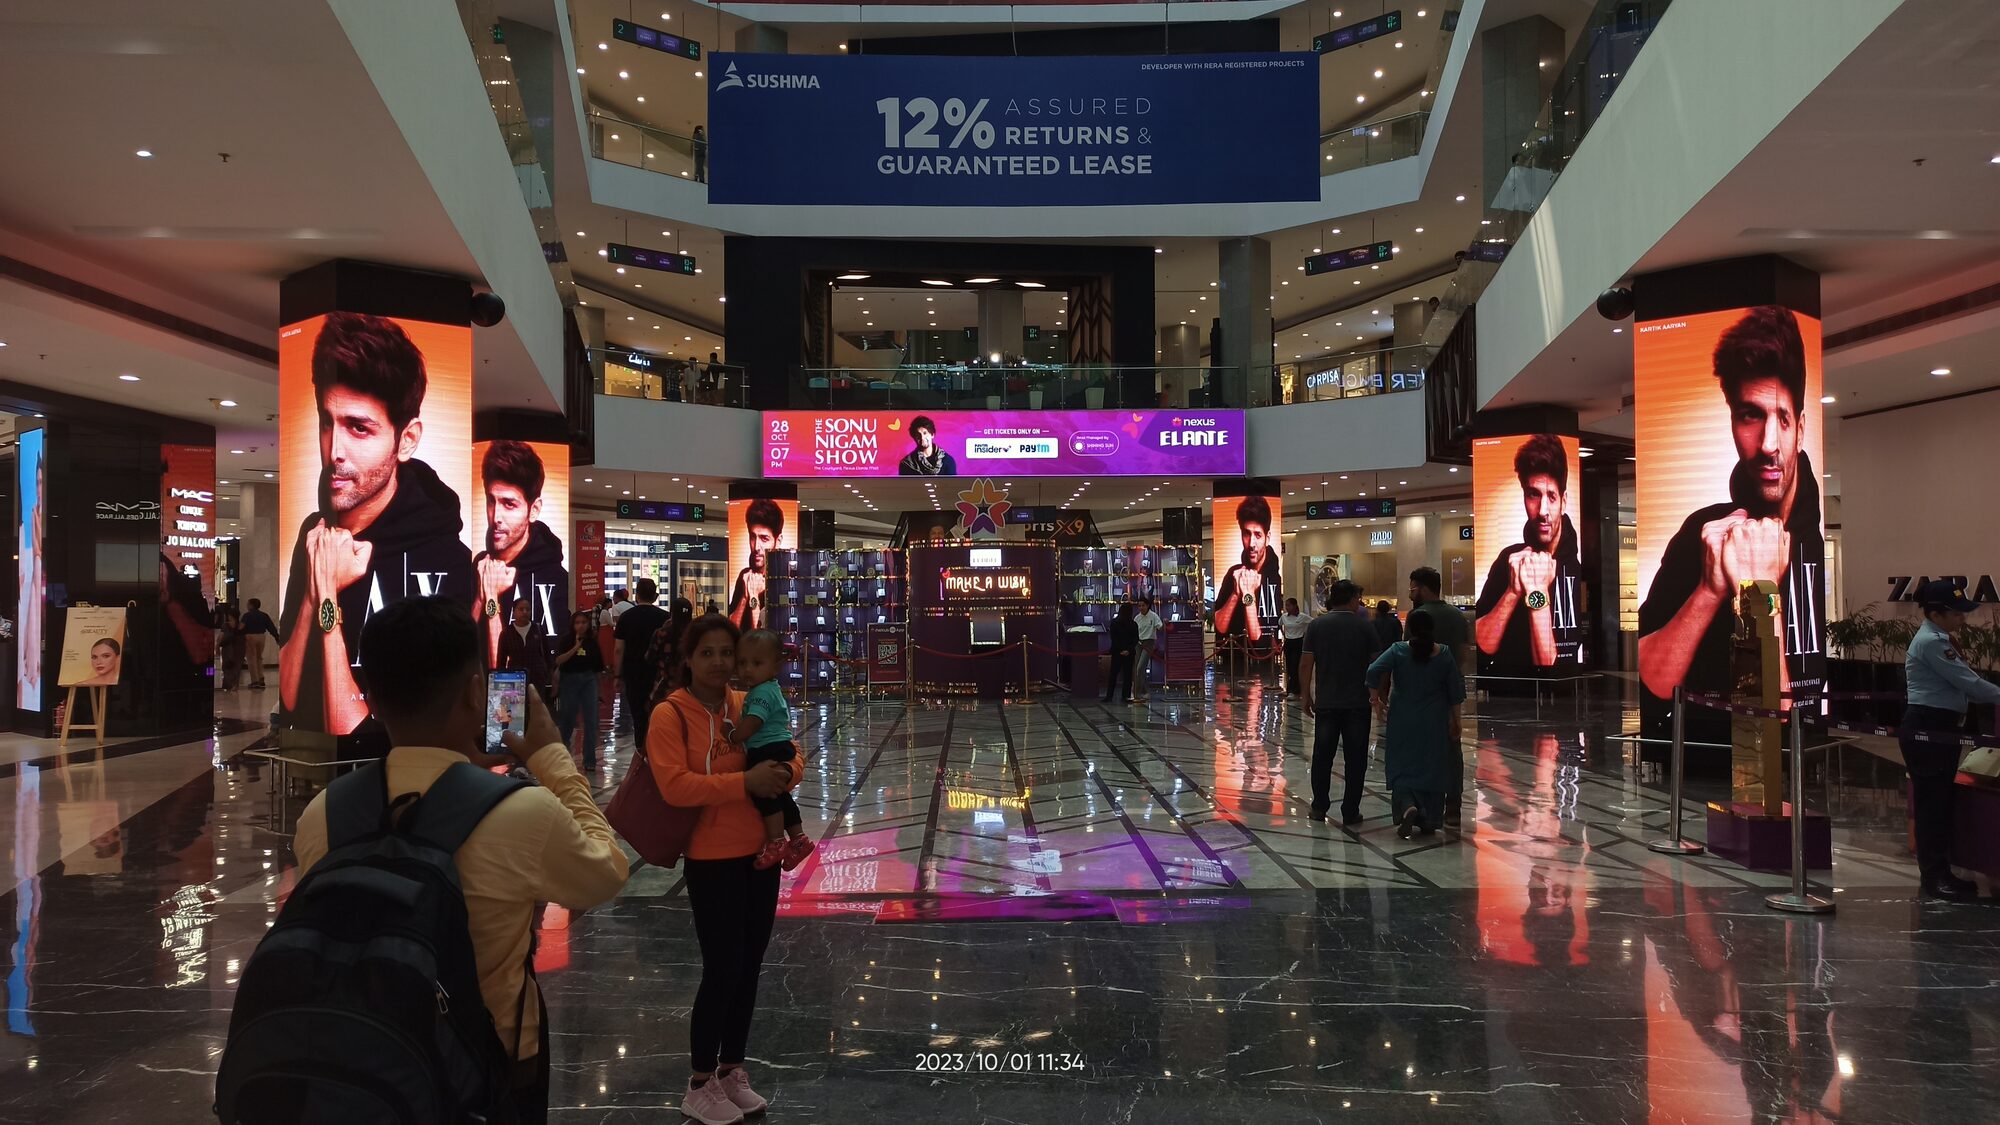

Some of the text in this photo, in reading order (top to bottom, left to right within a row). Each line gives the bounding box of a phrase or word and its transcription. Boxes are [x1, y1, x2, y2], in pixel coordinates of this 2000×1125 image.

[617, 24, 624, 34] 2
[1316, 40, 1322, 50] 2
[1141, 63, 1183, 71] DEVELOPER
[1184, 62, 1203, 70] WITH
[1224, 61, 1268, 69] REGISTERED
[1269, 60, 1305, 68] PROJECTS
[747, 74, 821, 89] SUSHMA
[1005, 98, 1152, 116] ASSURED
[876, 97, 996, 150] 12%
[1005, 126, 1152, 145] RETURNS &
[877, 155, 1152, 175] GUARANTEED LEASE
[612, 247, 618, 258] 1
[1307, 261, 1313, 271] 1
[1640, 322, 1687, 333] KARTIK AARYAN
[1306, 369, 1340, 389] CARPISA
[771, 420, 790, 433] 28
[815, 418, 823, 434] THE
[825, 418, 878, 433] SONU
[1183, 417, 1215, 427] nexus
[815, 434, 879, 449] NIGAM
[1159, 430, 1229, 447] ELANTE
[771, 448, 790, 460] 07
[974, 445, 1002, 454] insider
[1019, 444, 1050, 454] paytm
[815, 450, 879, 465] SHOW
[171, 487, 214, 503] MAC
[620, 504, 629, 514] G
[1309, 505, 1317, 516] G
[1371, 530, 1393, 541] RADO
[1462, 528, 1470, 538] G
[166, 535, 216, 549] JO MALONE
[945, 575, 1027, 593] MAKE A WISH
